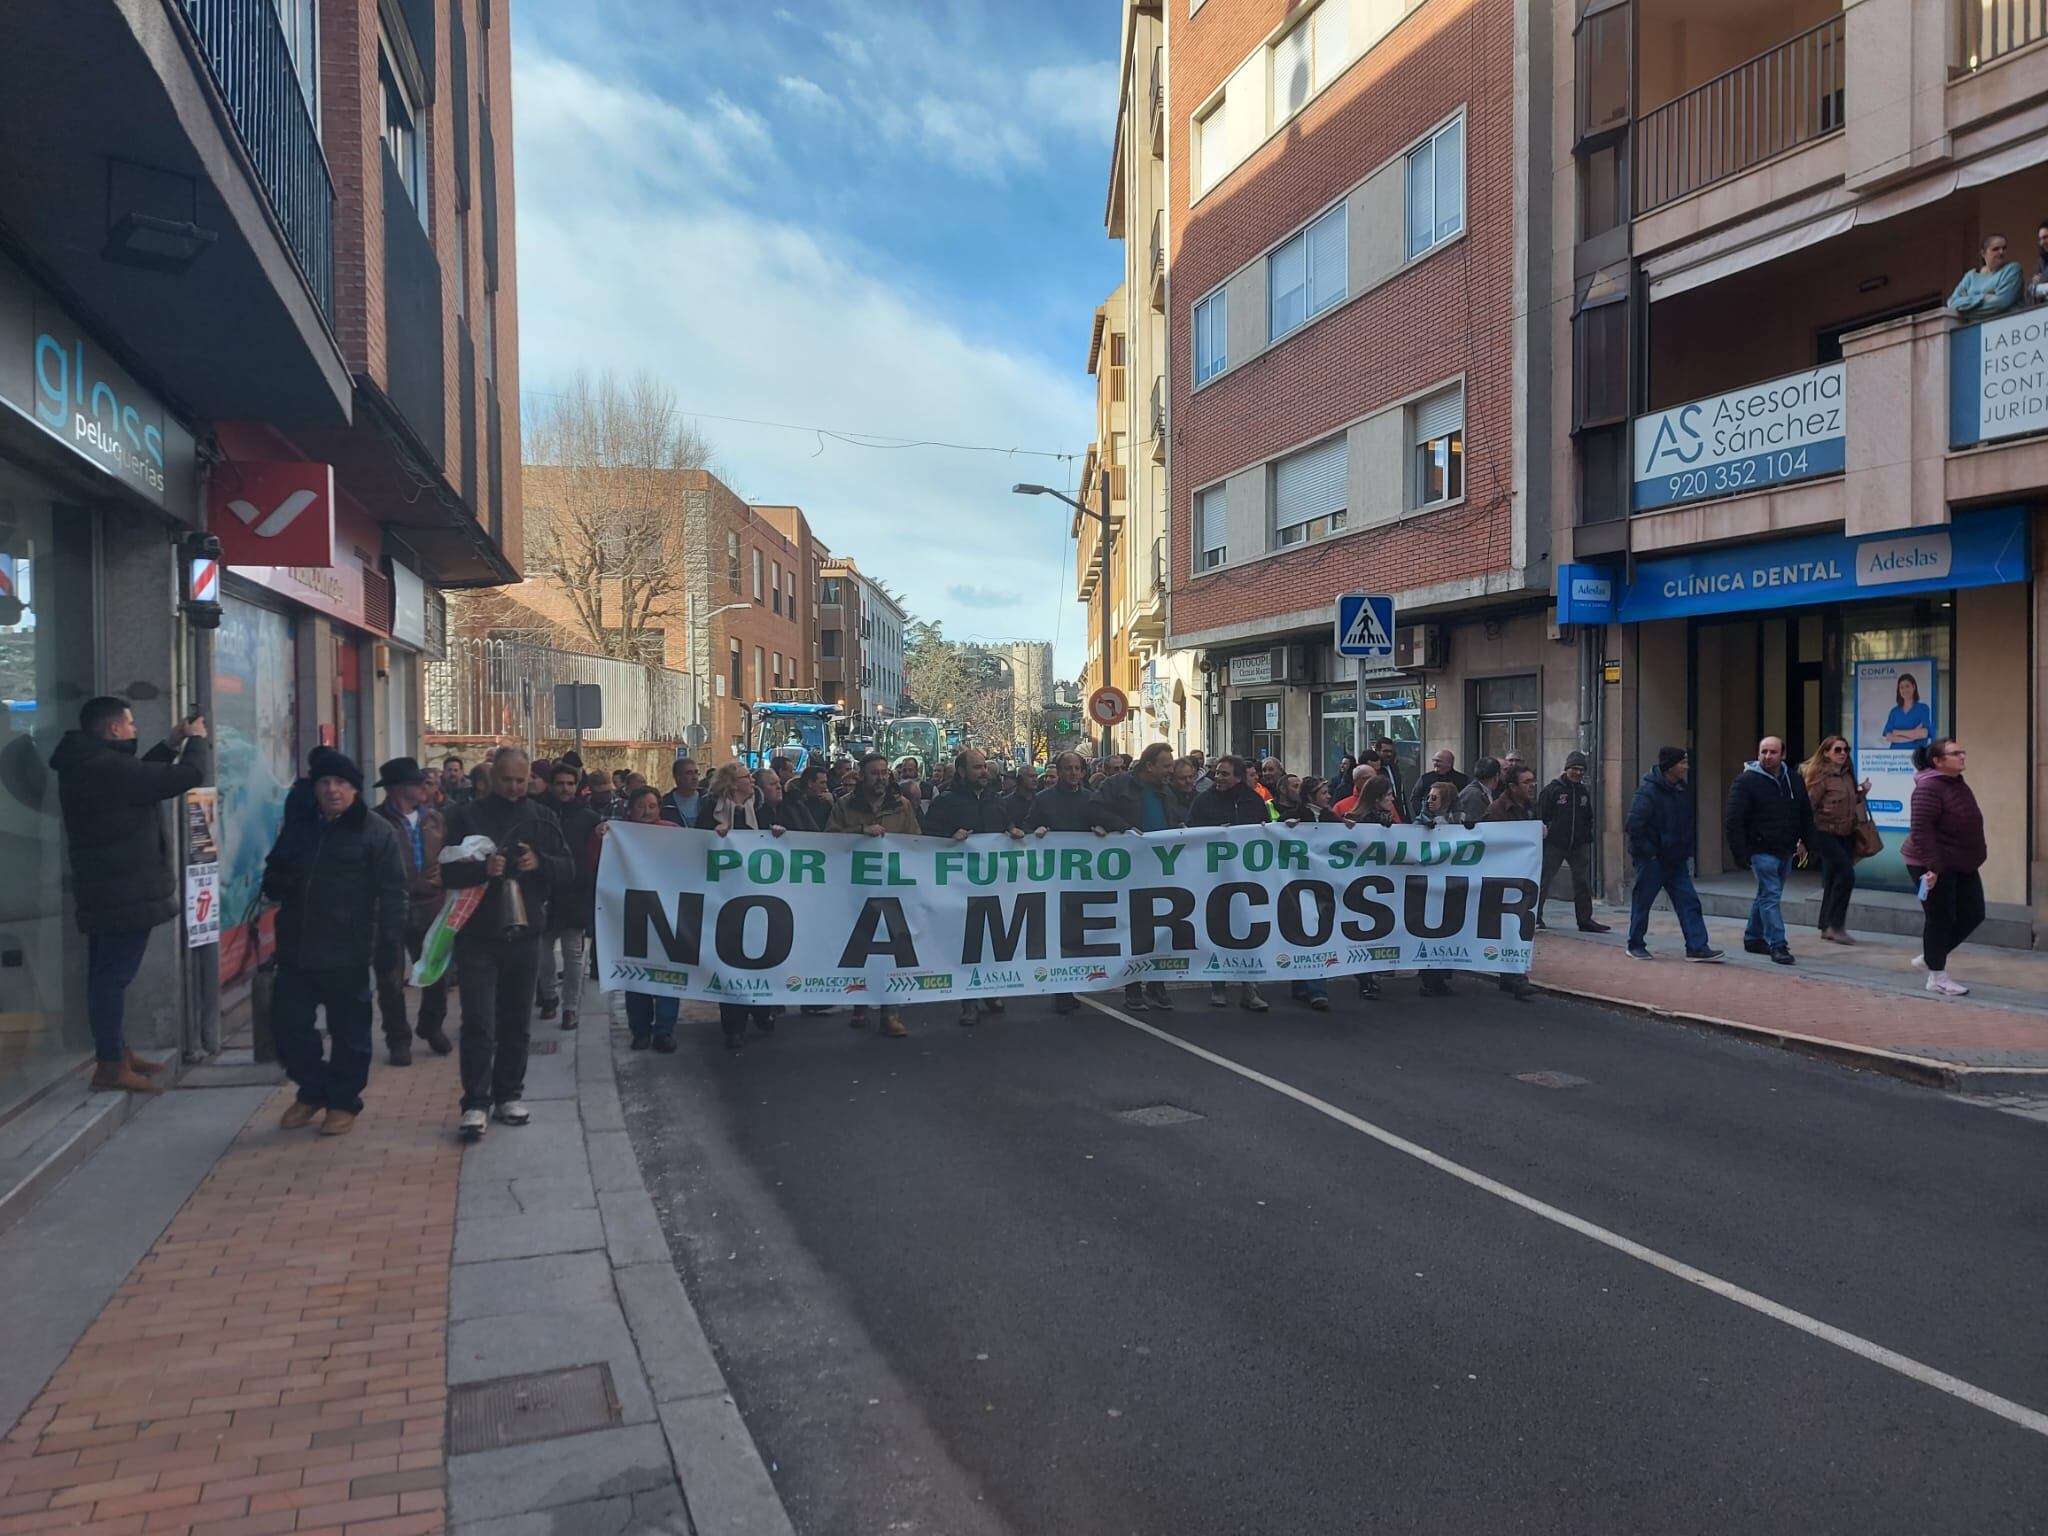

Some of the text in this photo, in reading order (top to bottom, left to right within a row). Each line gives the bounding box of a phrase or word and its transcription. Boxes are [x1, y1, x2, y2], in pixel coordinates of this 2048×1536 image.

[1985, 349, 2045, 376] FISCA
[1712, 369, 1841, 427] Asesoría
[1984, 372, 2048, 399] CONT
[1712, 408, 1841, 456] Sánchez
[75, 412, 165, 491] peluquerías
[1669, 448, 1808, 499] 920 352 104
[1869, 548, 1938, 573] Adeslas
[1663, 559, 1841, 598] CLÍNICA DENTAL
[1232, 655, 1270, 669] FOTOCOPI
[706, 839, 1486, 886] POR EL FUTURO Y POR SALUD
[623, 875, 1538, 970] NO A MERCOSUR
[1222, 955, 1264, 968] ASAJA
[1430, 945, 1469, 958] ASAJA
[725, 977, 770, 991] ASAJA
[983, 971, 1021, 984] ASAJA
